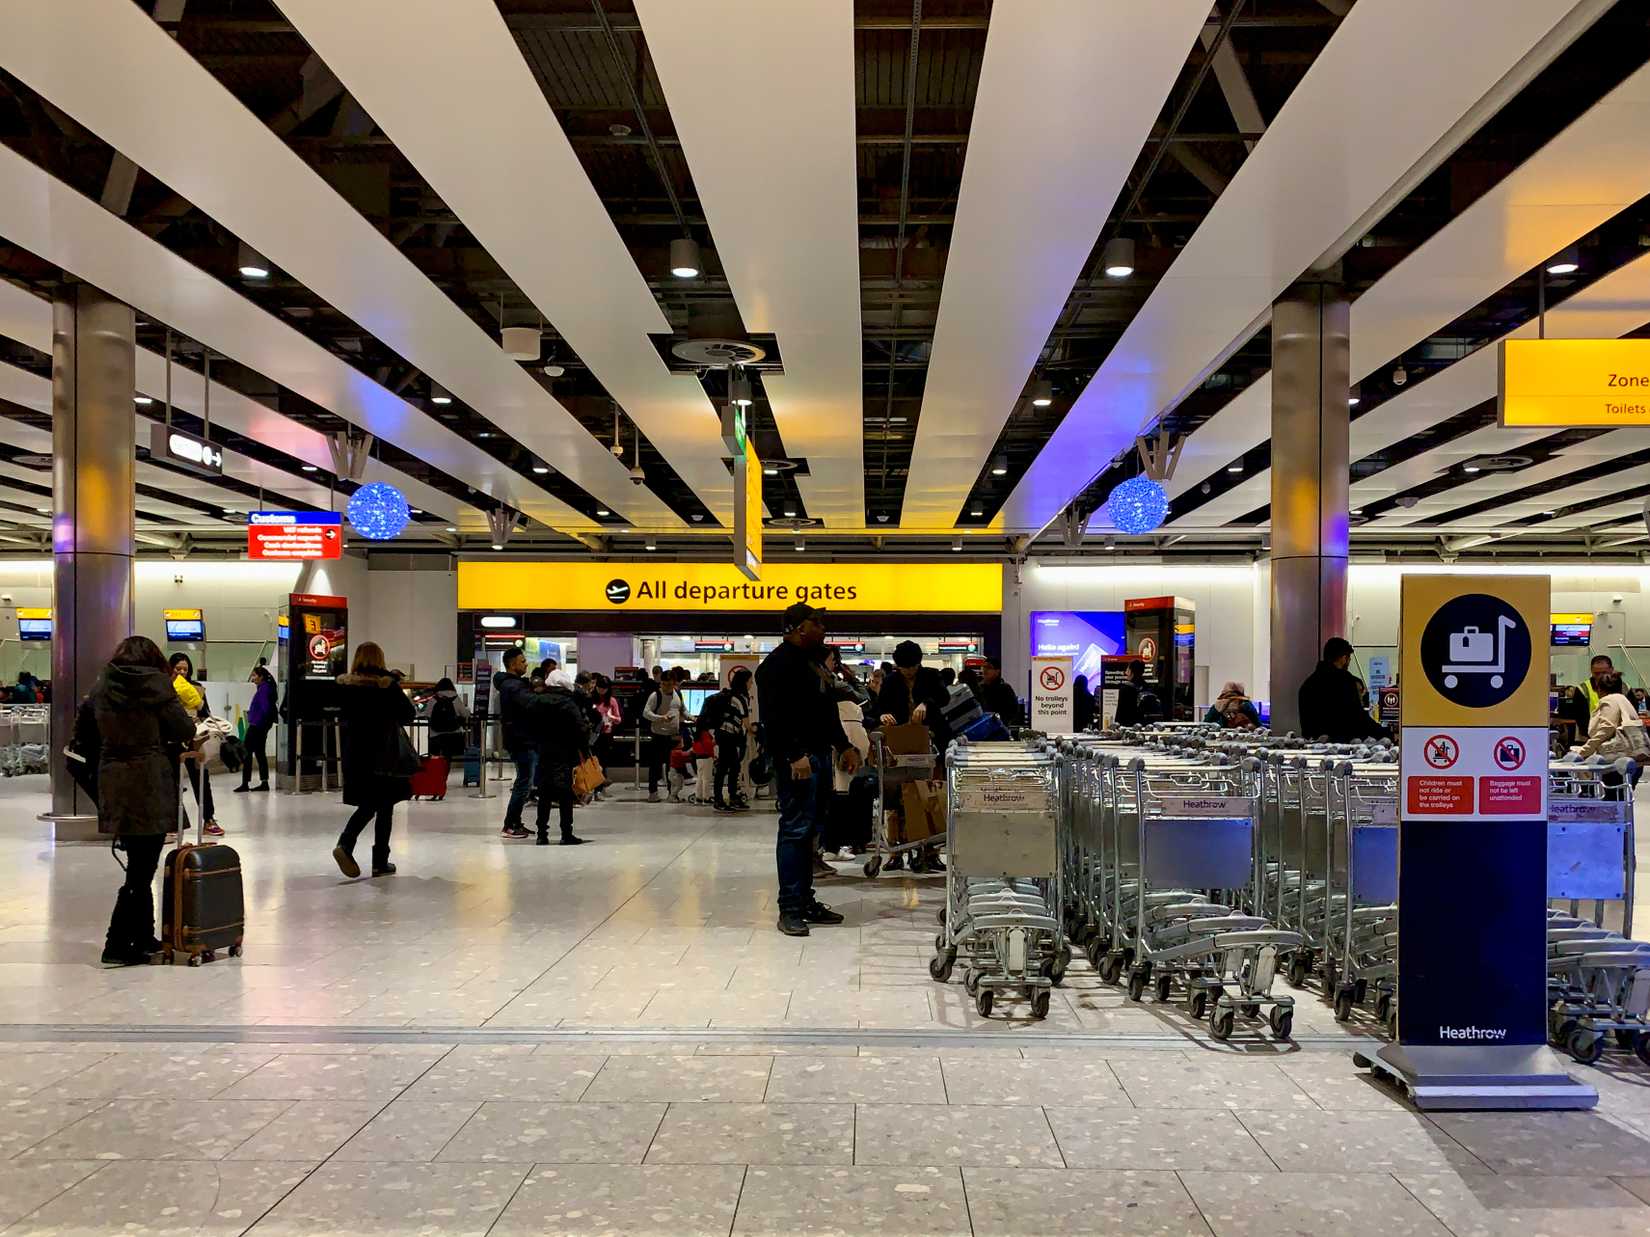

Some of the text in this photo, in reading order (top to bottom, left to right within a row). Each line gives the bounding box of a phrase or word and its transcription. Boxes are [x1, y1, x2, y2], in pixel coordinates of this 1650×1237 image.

[1607, 373, 1650, 387] Zone
[1605, 403, 1646, 414] Toilets
[637, 580, 857, 604] All departure gates
[983, 793, 1025, 802] Heathrow
[1183, 800, 1226, 809] Heathrow
[1440, 1025, 1507, 1040] Heathrow
